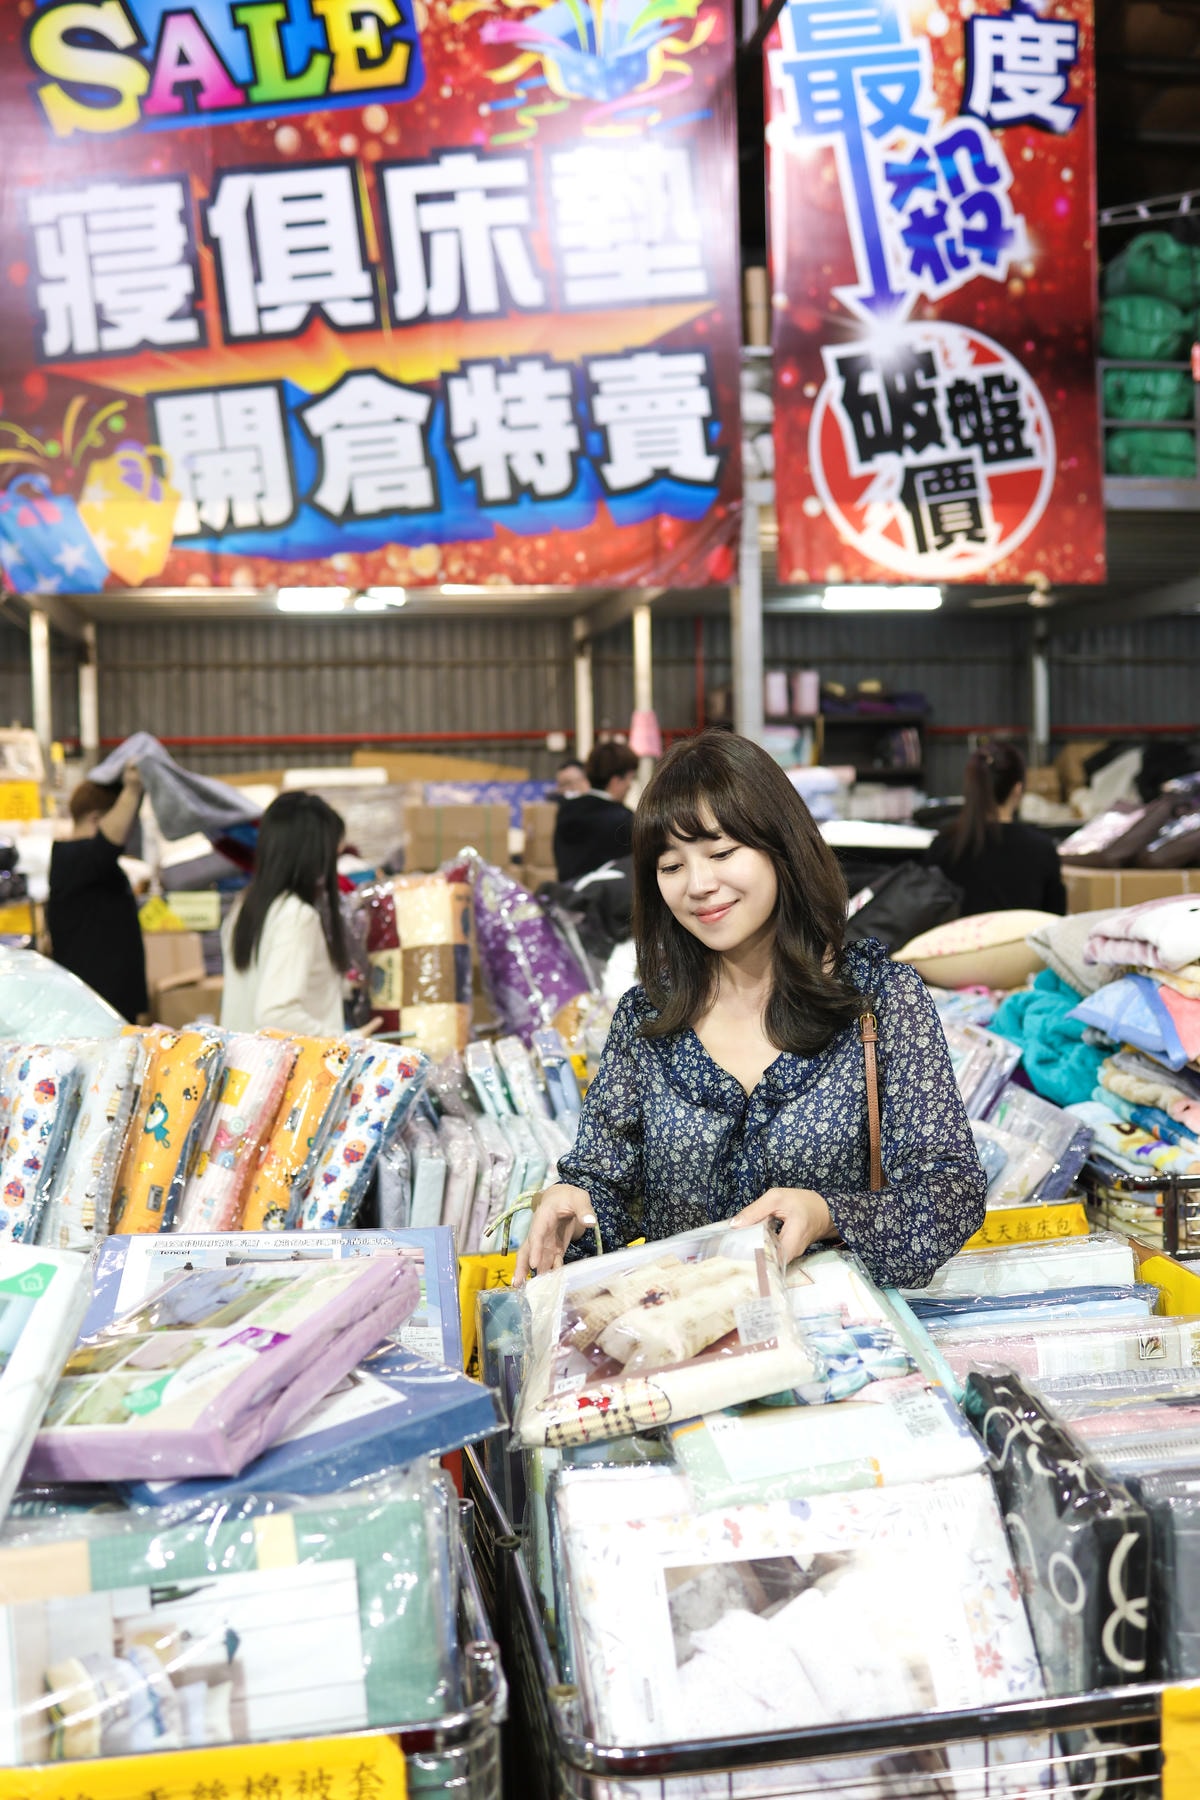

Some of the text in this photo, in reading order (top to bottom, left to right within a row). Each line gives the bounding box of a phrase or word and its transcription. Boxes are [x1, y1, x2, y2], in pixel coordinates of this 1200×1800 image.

[30, 0, 413, 135] SALE
[154, 352, 720, 536] 開倉特賣
